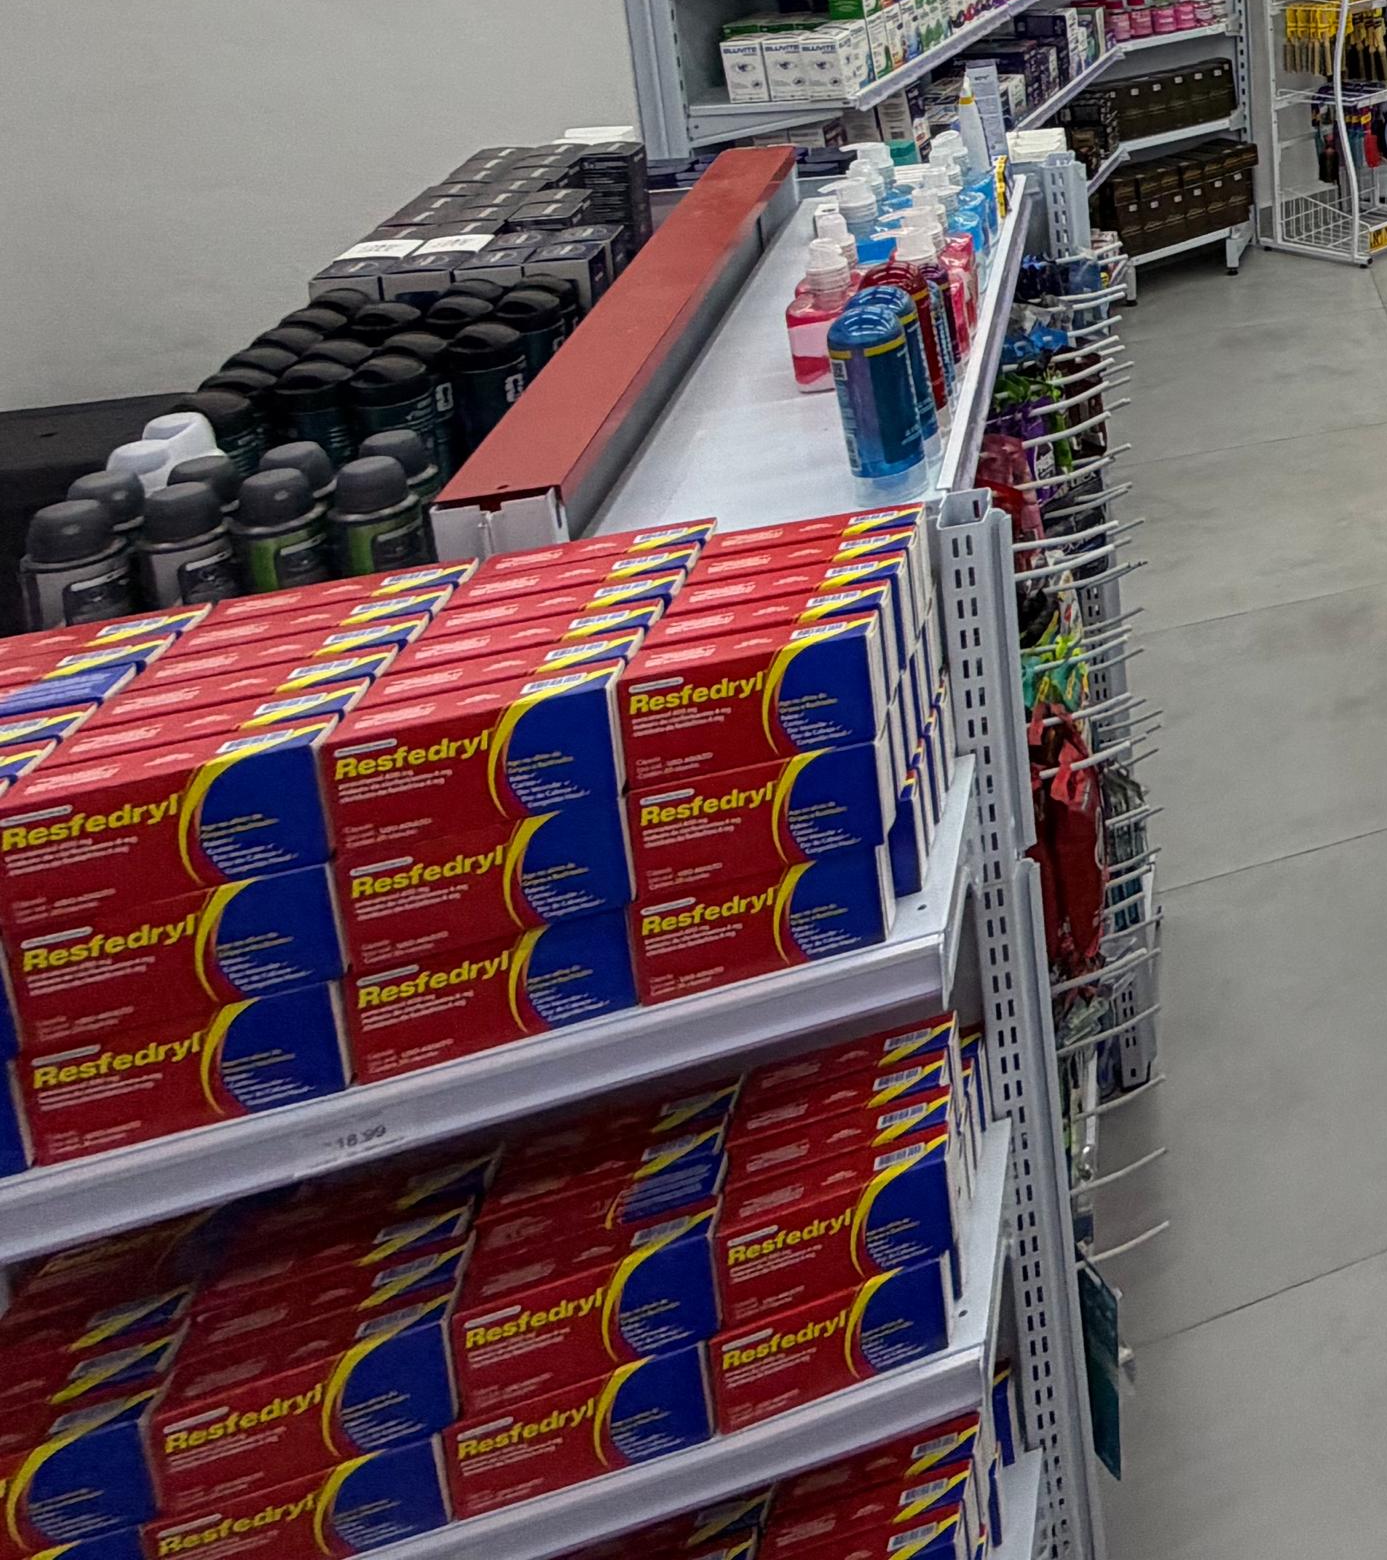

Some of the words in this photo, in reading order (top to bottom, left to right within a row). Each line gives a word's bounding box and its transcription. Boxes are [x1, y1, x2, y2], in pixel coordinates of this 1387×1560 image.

[630, 670, 764, 716] Resfedryl
[335, 729, 489, 781] Resfedryl
[2, 793, 179, 852] Resfedryl
[639, 780, 774, 827] Resfedryl
[351, 845, 504, 900] Resfedryl
[641, 886, 775, 936] Resfedryl
[22, 914, 195, 972] Resfedryl
[357, 950, 509, 1009] Resfedryl
[33, 1032, 201, 1089] Resfedryl
[727, 1208, 852, 1266] Resfedryl
[466, 1289, 603, 1348] Resfedryl
[722, 1310, 847, 1370] Resfedryl
[164, 1384, 323, 1454] Resfedryl
[457, 1399, 594, 1461] Resfedryl
[157, 1493, 313, 1557] Resfedryl
